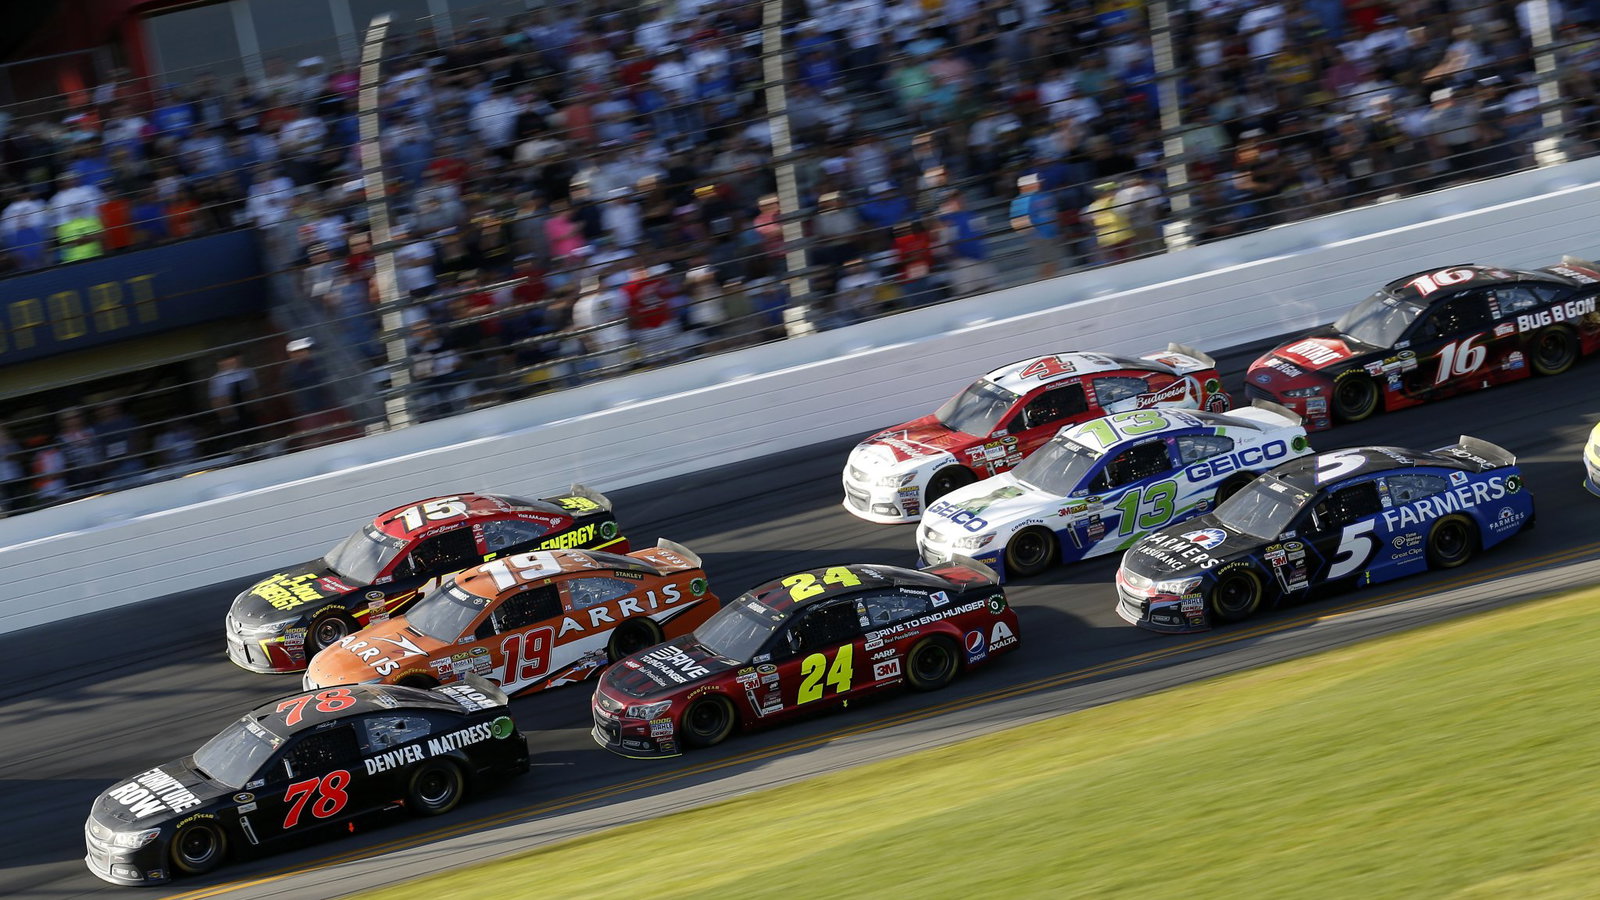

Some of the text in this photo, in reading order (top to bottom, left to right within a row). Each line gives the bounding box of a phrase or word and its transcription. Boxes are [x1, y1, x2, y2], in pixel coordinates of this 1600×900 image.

[1404, 269, 1474, 297] 16
[1517, 311, 1551, 332] BUG
[1551, 305, 1565, 322] B
[1565, 297, 1597, 319] GON
[1019, 356, 1077, 380] 4
[1433, 333, 1486, 385] 16
[1136, 386, 1191, 409] Budweiser
[1074, 410, 1171, 448] 13
[1185, 440, 1288, 482] GEICO
[1315, 449, 1369, 484] 5
[394, 496, 470, 533] 15
[928, 501, 988, 532] GEICO
[1113, 479, 1177, 537] 13
[1382, 476, 1506, 532] FARMERS
[1490, 512, 1525, 530] FARMERS
[541, 524, 595, 550] ENERGY
[1011, 519, 1044, 532] GOODYEAR
[1138, 545, 1187, 571] INSURANCE
[1144, 532, 1220, 569] FARMERS
[1327, 518, 1375, 579] 5
[477, 551, 562, 591] 19
[615, 571, 642, 579] STANLEY
[781, 566, 862, 603] 24
[1218, 562, 1249, 575] GOODYEAR
[900, 588, 928, 596] Panasonic
[312, 604, 345, 618] GOODYEAR
[558, 583, 681, 638] ARRIS
[864, 600, 985, 643] DRIVE TO END HUNGER
[340, 635, 400, 676] ARRIS
[501, 626, 555, 687] 19
[871, 648, 896, 660] AARP
[970, 652, 986, 663] pepsi
[989, 636, 1017, 652] AXALTA
[439, 664, 451, 673] 3M
[649, 645, 711, 679] DRIVE
[797, 644, 853, 705] 24
[877, 662, 897, 676] 3M
[687, 685, 720, 699] GOODYEAR
[745, 680, 759, 689] 3M
[276, 688, 357, 726] 78
[364, 721, 493, 776] DENVER MATTRESS
[109, 781, 167, 818] ROW
[133, 767, 202, 813] FURNITURE
[283, 769, 350, 829] 78
[176, 812, 215, 829] GOODYEAR
